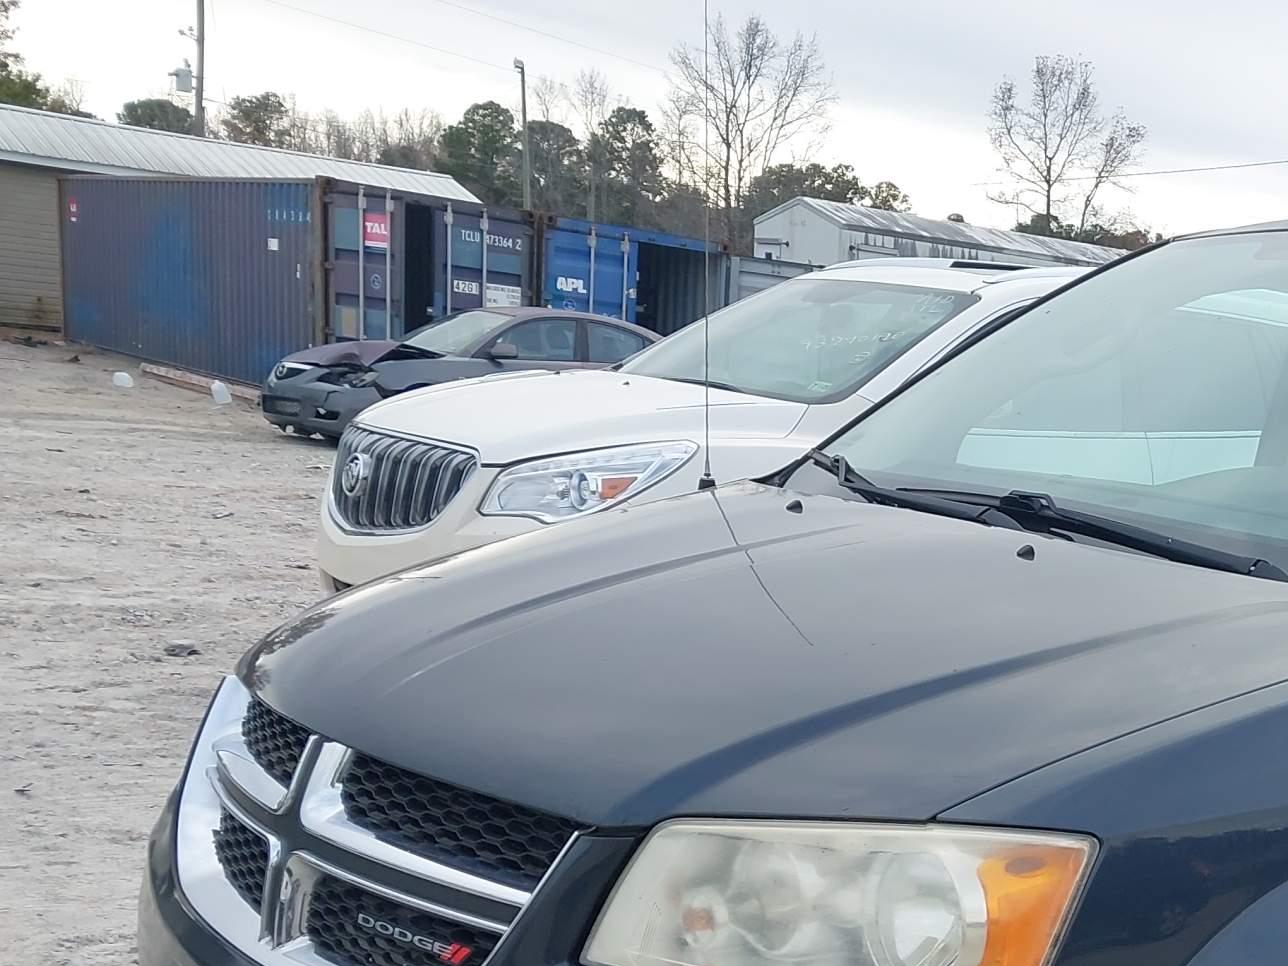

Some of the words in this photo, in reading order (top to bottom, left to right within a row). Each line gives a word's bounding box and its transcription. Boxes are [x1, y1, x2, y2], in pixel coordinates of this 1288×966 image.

[364, 221, 388, 234] TAL
[461, 229, 480, 242] TCLU
[515, 238, 523, 251] 2
[556, 275, 588, 294] APL
[357, 912, 452, 960] DODGE
